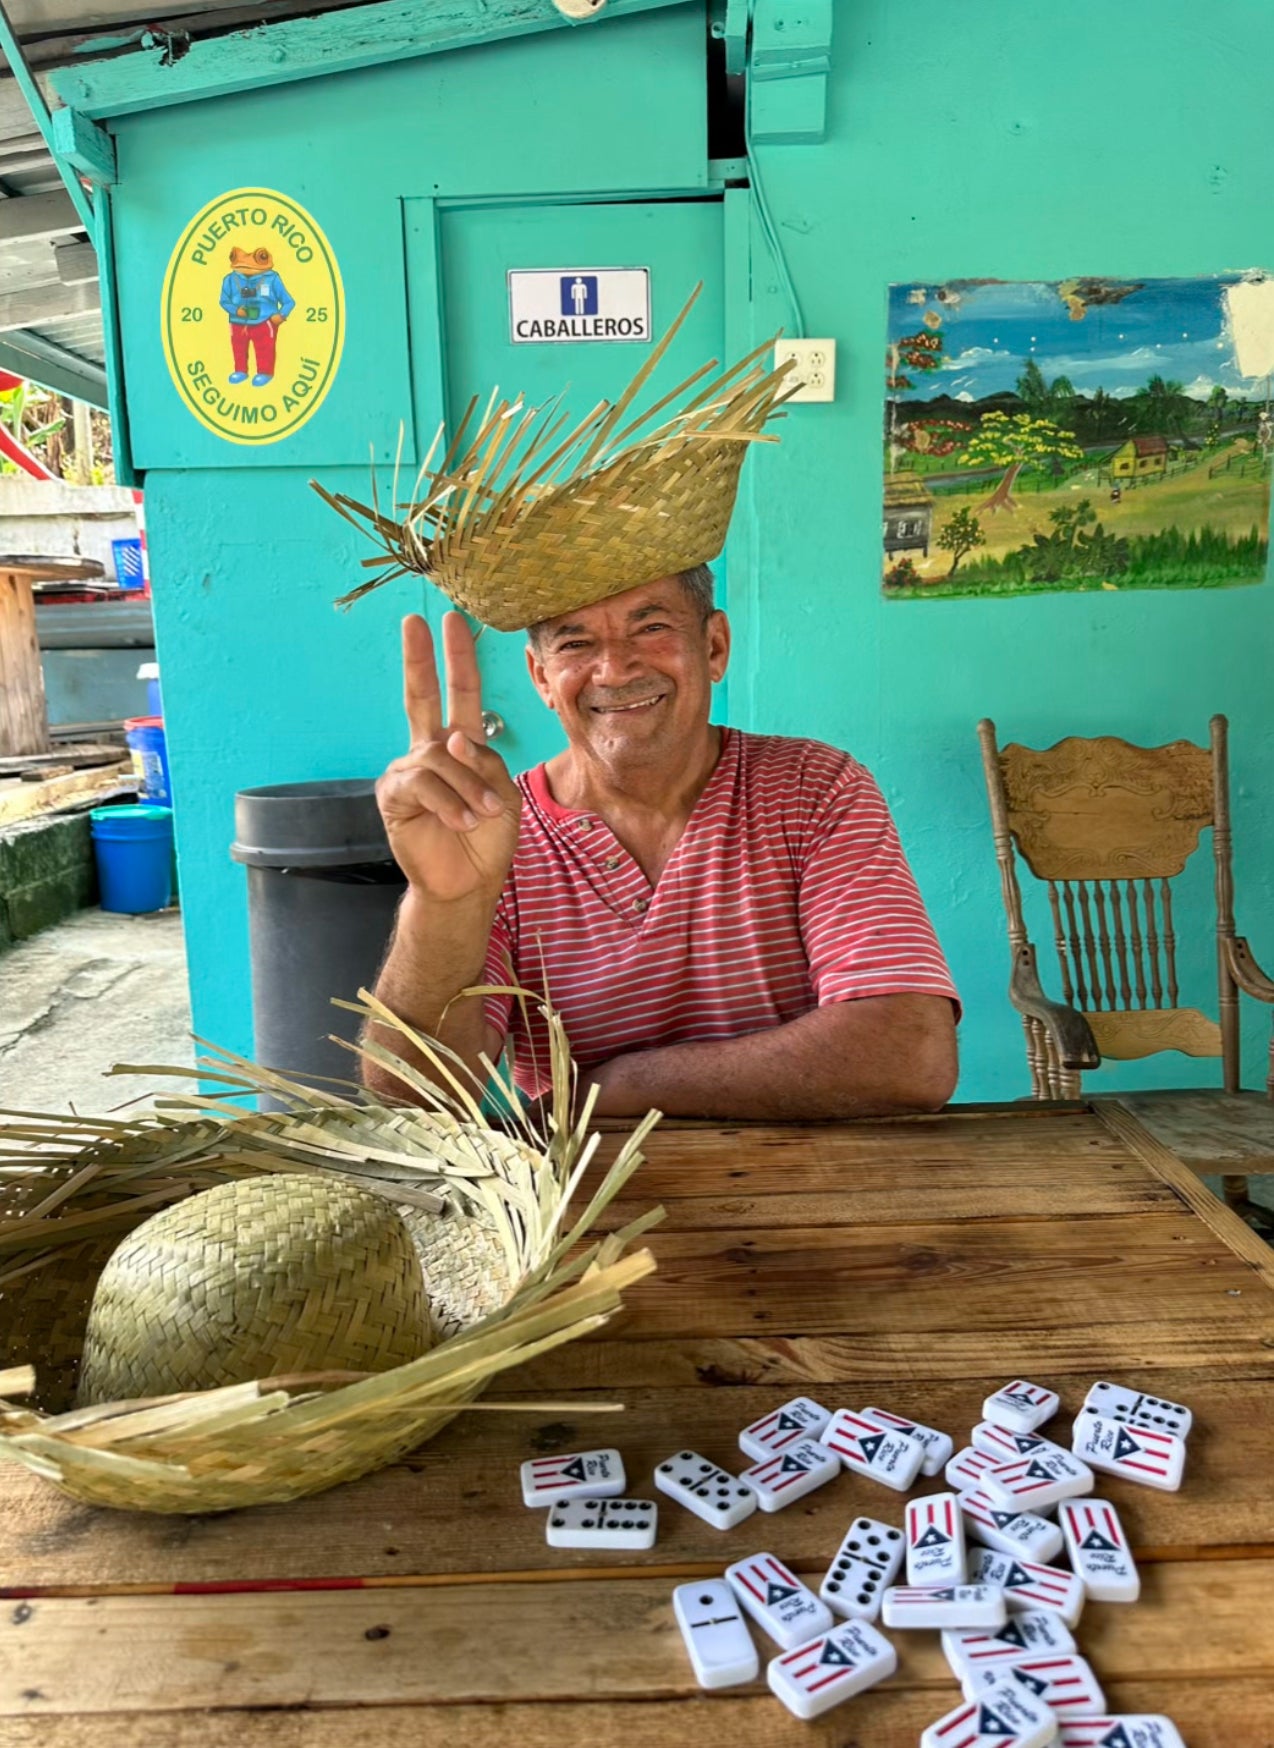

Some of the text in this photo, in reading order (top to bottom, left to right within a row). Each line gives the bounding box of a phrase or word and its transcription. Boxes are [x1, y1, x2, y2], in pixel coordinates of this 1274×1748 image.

[191, 208, 314, 266] PUERTO RICO
[181, 307, 328, 322] 20 25
[517, 317, 644, 338] CABALLEROS
[187, 357, 321, 424] SEGUIMO AQUÍ
